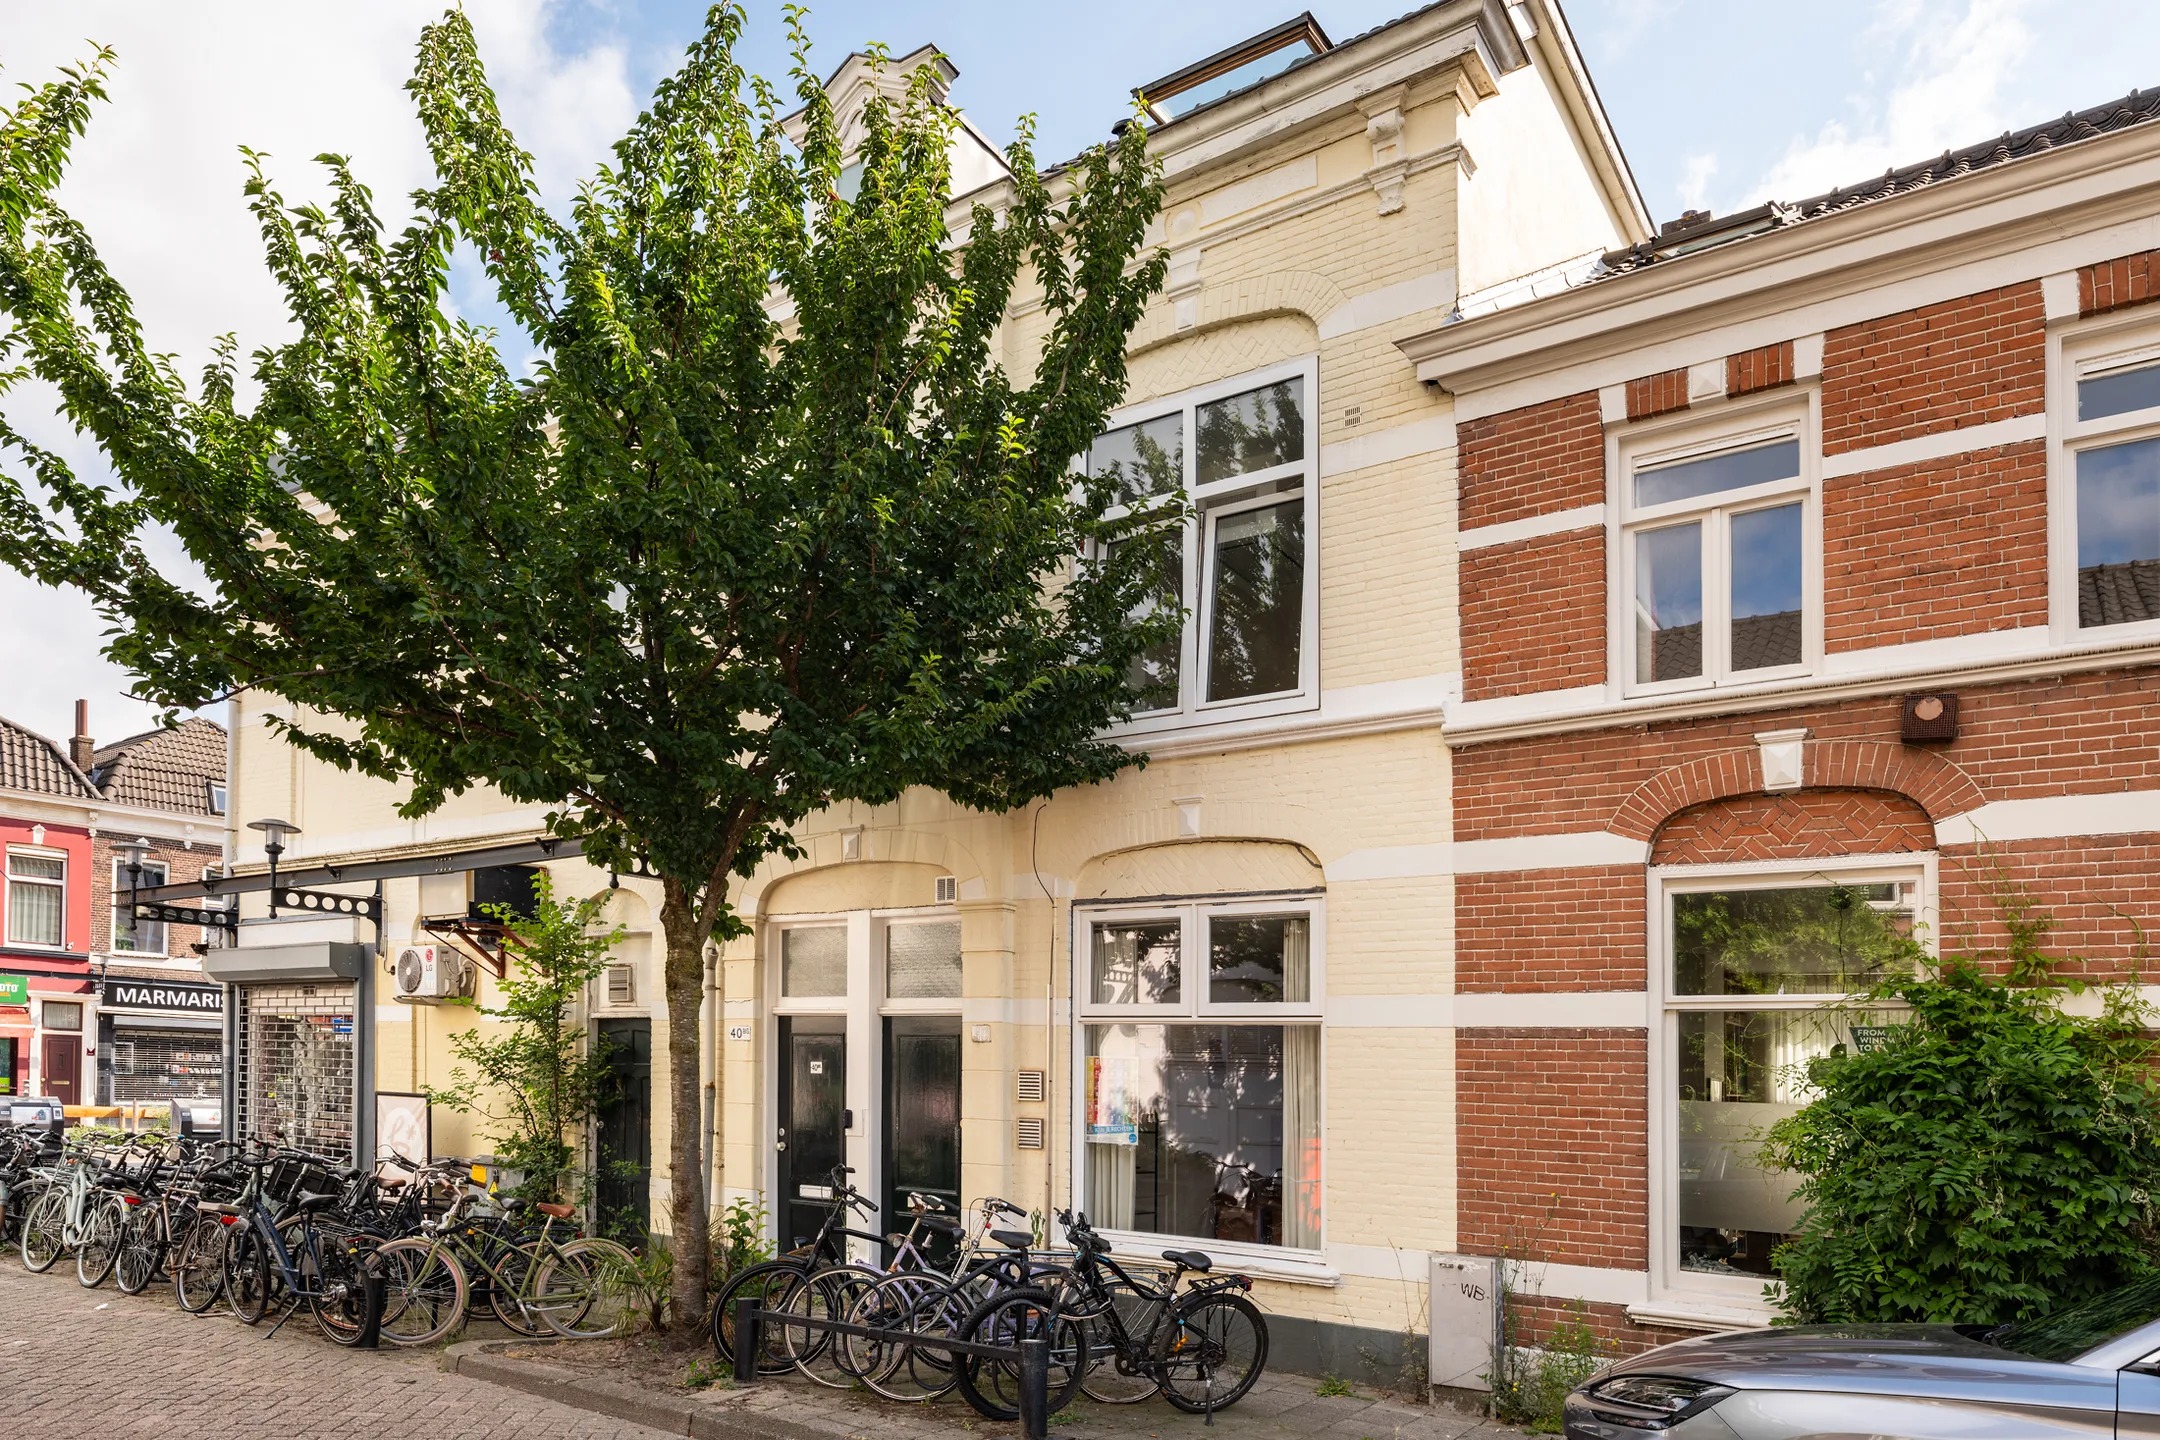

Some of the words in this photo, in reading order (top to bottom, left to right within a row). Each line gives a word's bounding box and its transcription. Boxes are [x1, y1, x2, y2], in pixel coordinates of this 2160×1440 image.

[116, 987, 224, 1008] MARMARI
[1858, 1044, 1872, 1052] TO
[1461, 1282, 1486, 1301] WB
